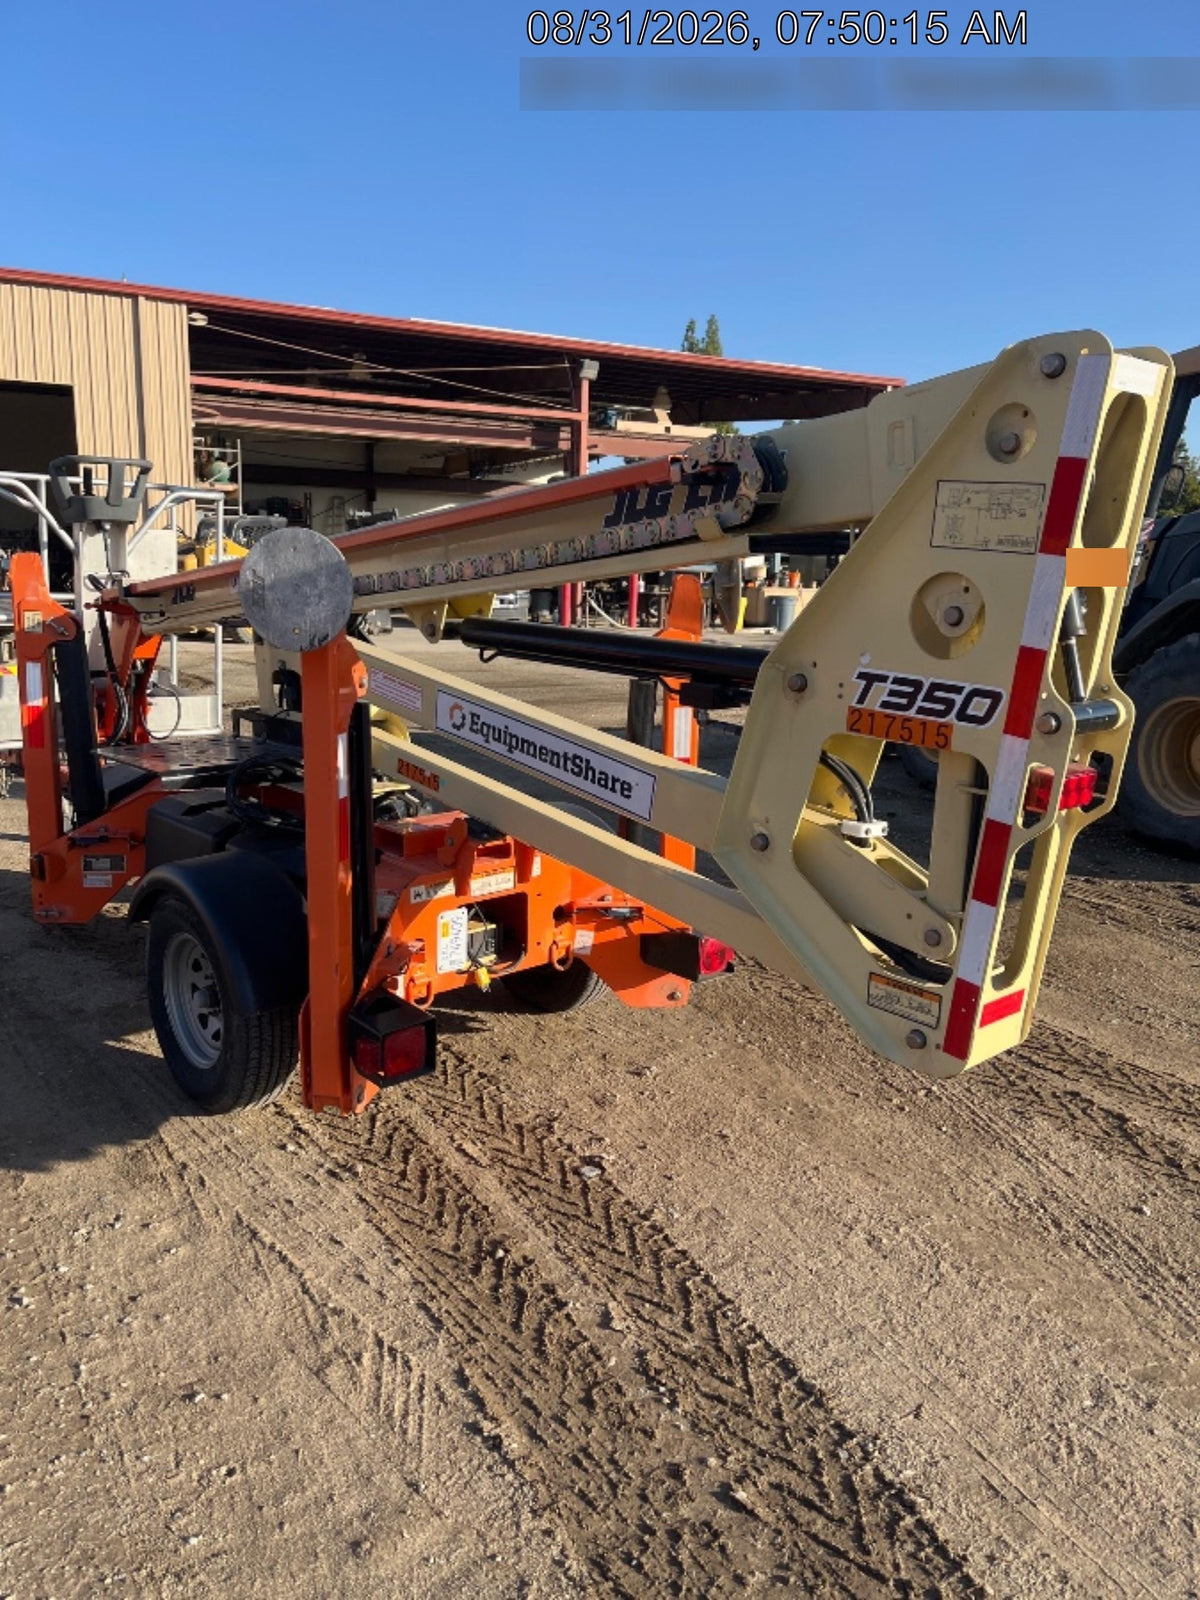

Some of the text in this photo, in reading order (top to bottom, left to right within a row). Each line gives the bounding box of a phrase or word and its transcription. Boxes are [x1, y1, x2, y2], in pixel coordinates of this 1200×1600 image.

[604, 483, 674, 528] JLG
[854, 670, 1004, 727] T350
[849, 708, 950, 749] 217515
[468, 710, 634, 801] EquipmentShare
